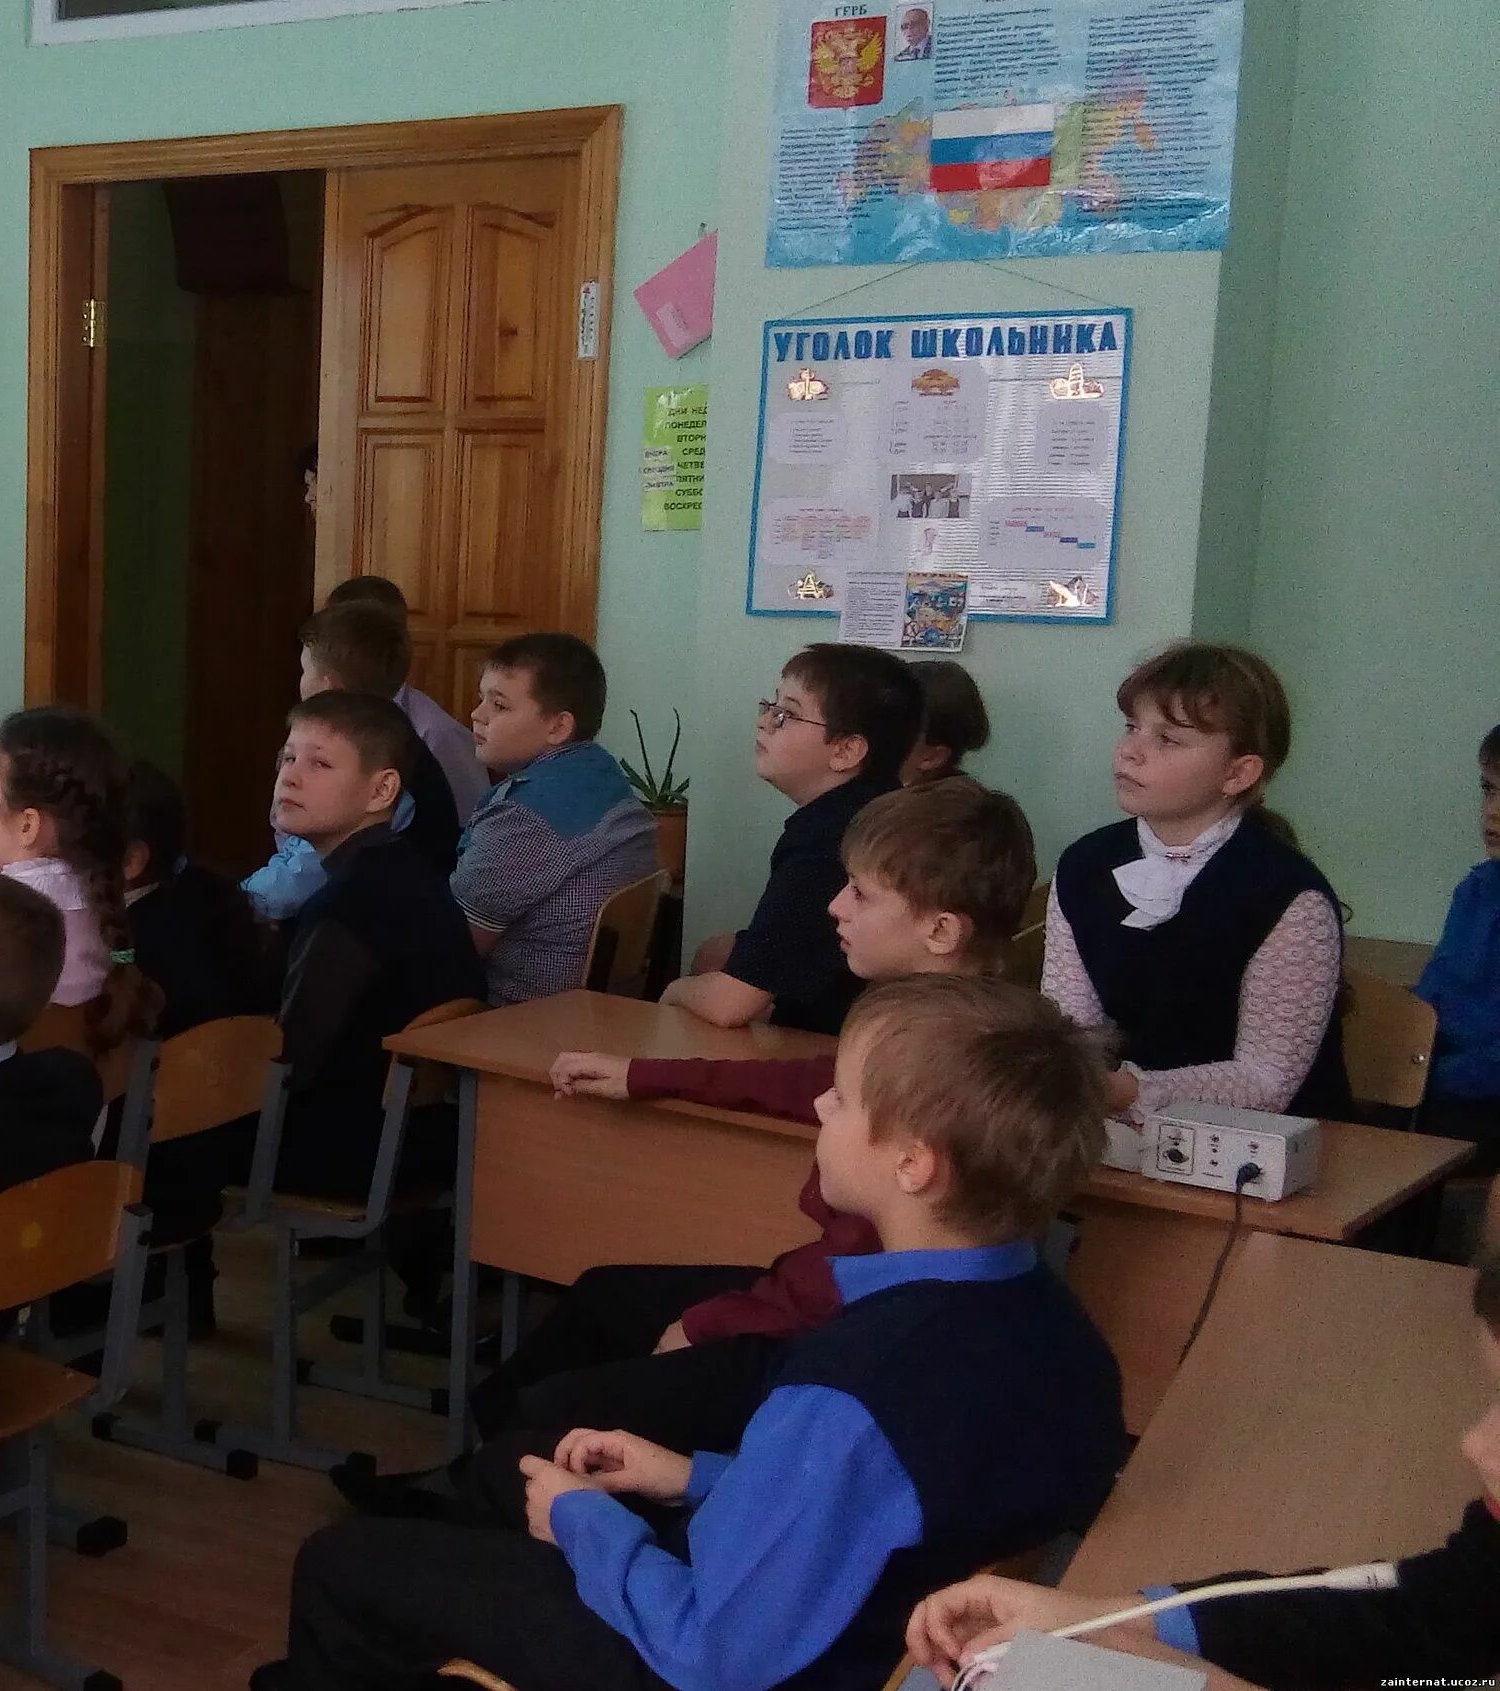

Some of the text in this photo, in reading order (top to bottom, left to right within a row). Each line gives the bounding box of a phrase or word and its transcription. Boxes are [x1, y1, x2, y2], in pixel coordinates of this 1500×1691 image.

[835, 4, 868, 17] ГЕРБ
[773, 321, 1118, 362] УГОЛОК ШКОЛЬНИКА
